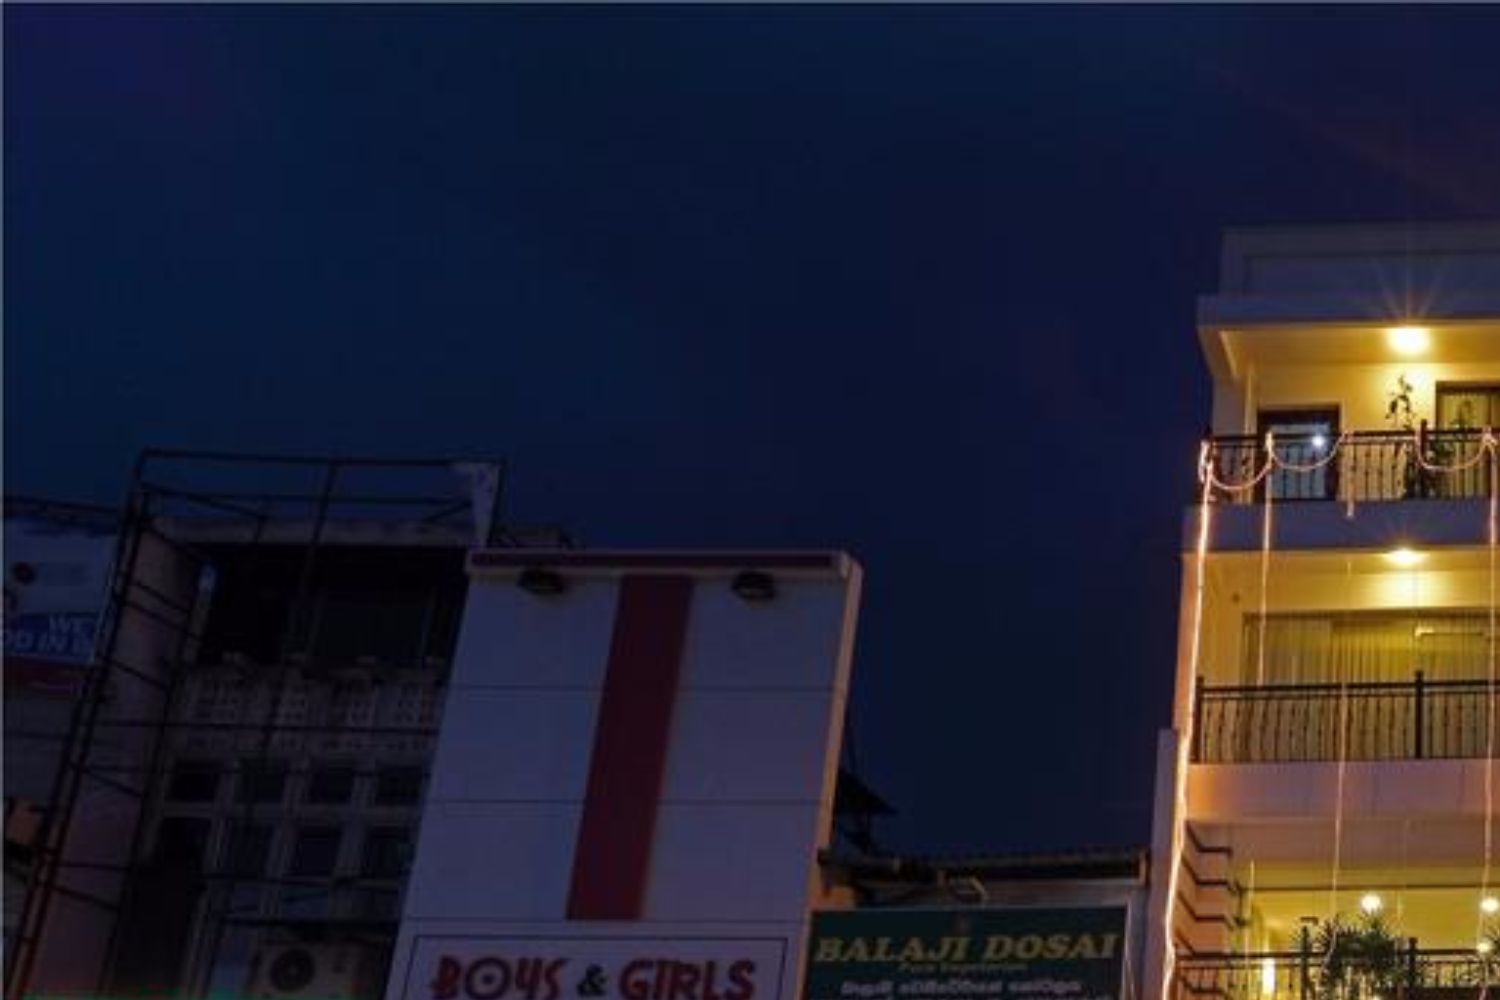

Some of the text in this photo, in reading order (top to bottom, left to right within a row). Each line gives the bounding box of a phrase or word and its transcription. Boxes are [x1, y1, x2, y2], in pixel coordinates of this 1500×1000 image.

[814, 932, 1122, 963] BALAJI DOSAI
[576, 964, 606, 998] &
